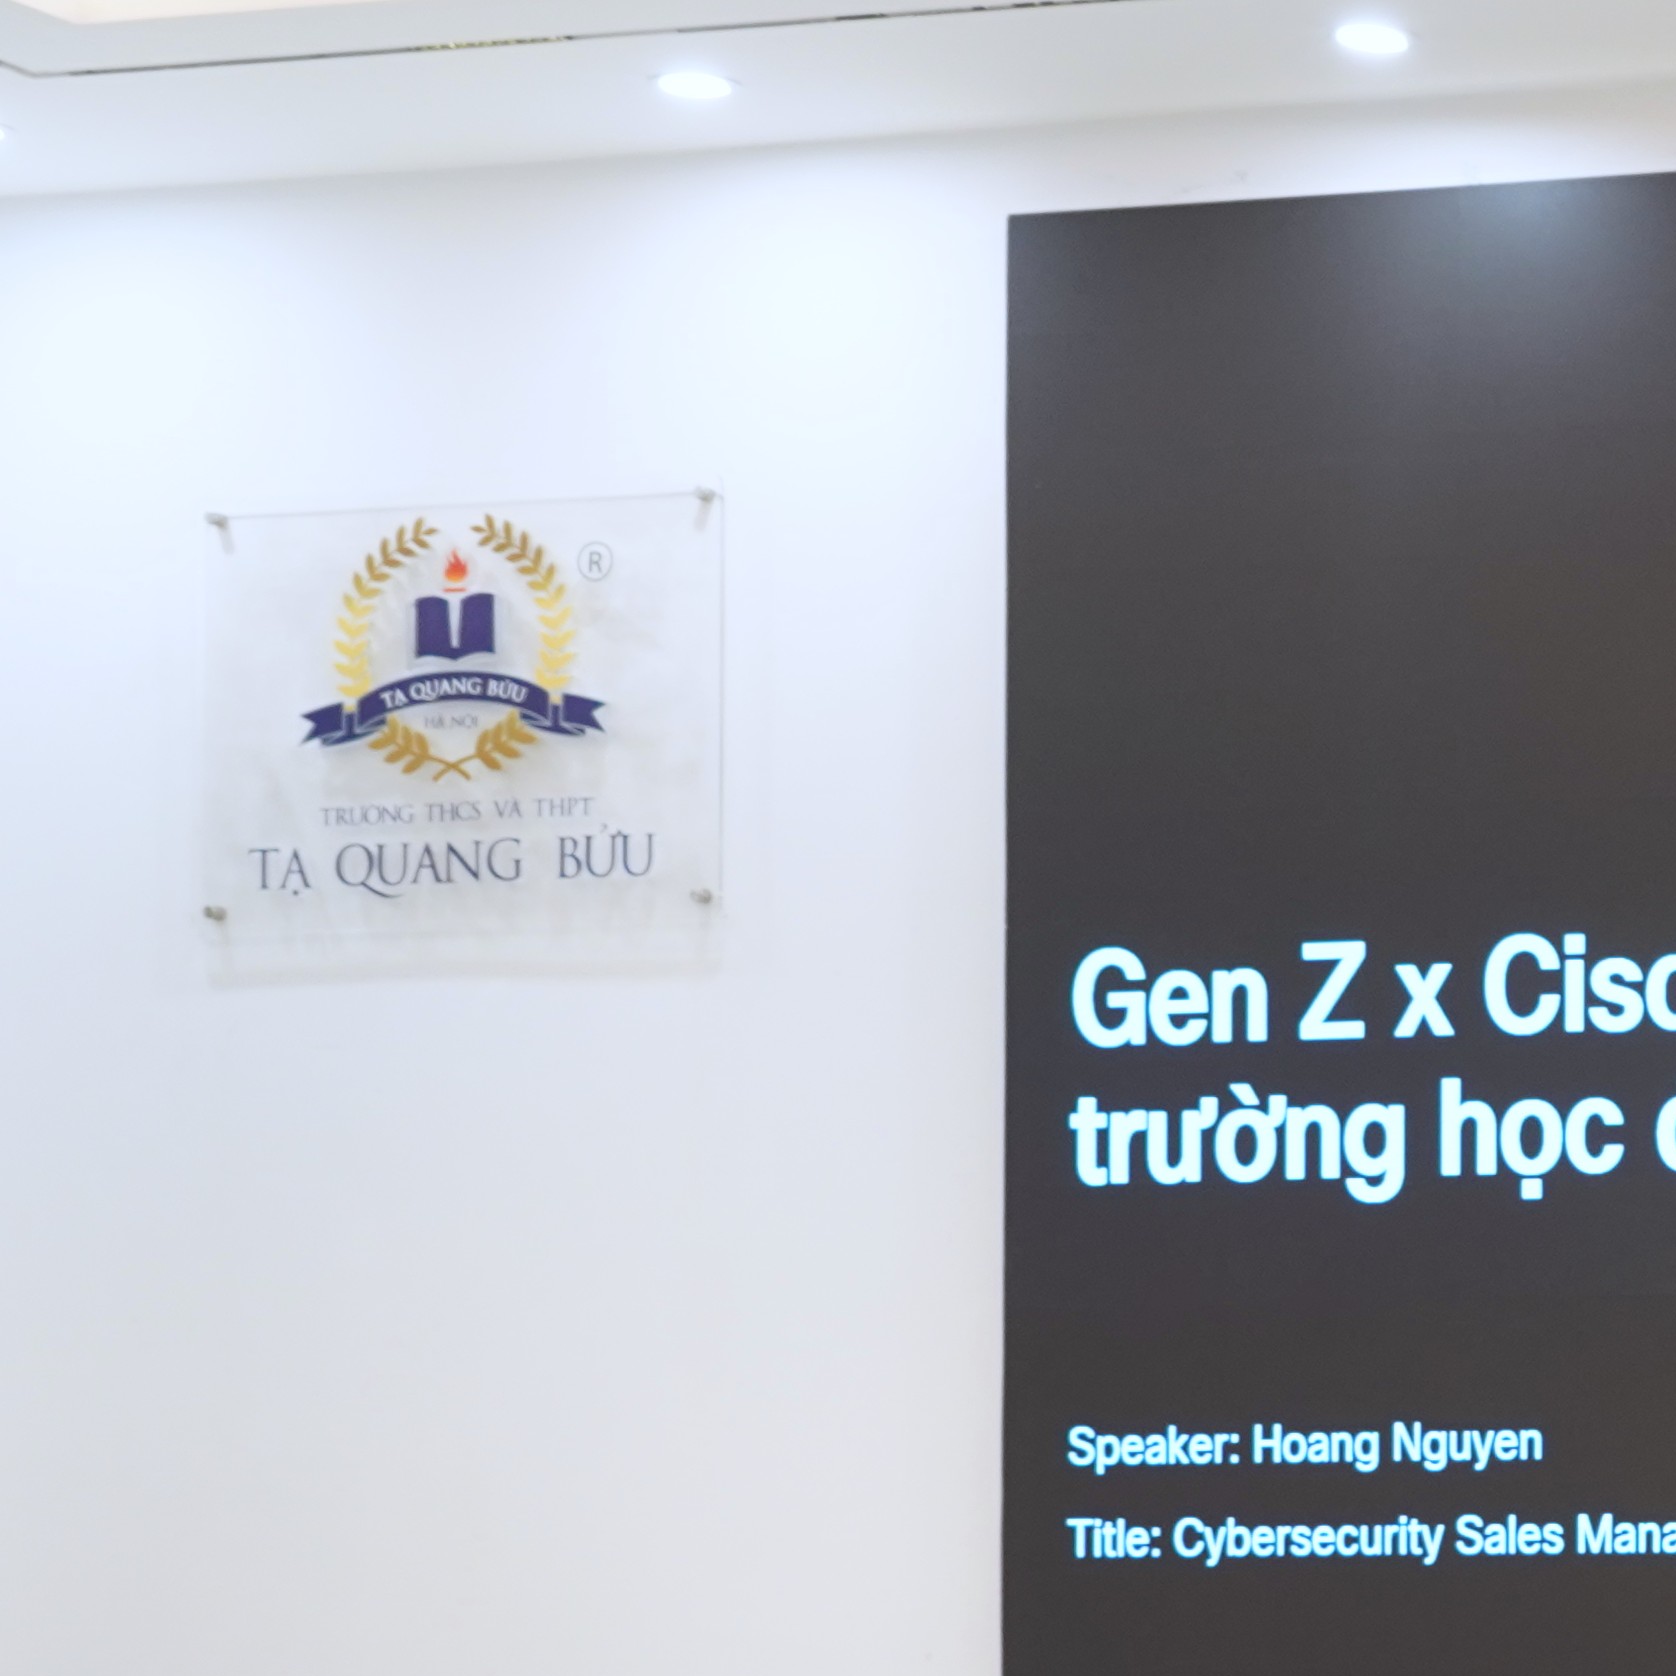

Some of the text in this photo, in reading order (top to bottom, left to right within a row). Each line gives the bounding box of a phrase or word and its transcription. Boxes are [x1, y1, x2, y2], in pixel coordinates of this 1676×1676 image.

[409, 676, 484, 701] QUANG
[425, 799, 482, 823] THCS
[493, 796, 524, 820] VÀ
[534, 796, 596, 819] THPT
[248, 821, 657, 899] TẠ QUANG BỬU
[1071, 945, 1269, 1049] Gen
[1299, 940, 1367, 1041] Z
[1393, 962, 1455, 1038] x
[1068, 1082, 1406, 1205] trường
[1440, 1077, 1625, 1200] học
[1066, 1421, 1544, 1476] Speaker: Hoang Nguyen
[1065, 1517, 1162, 1560] Title:
[1172, 1514, 1445, 1568] Cybersecurity
[1454, 1514, 1565, 1557] Sales
